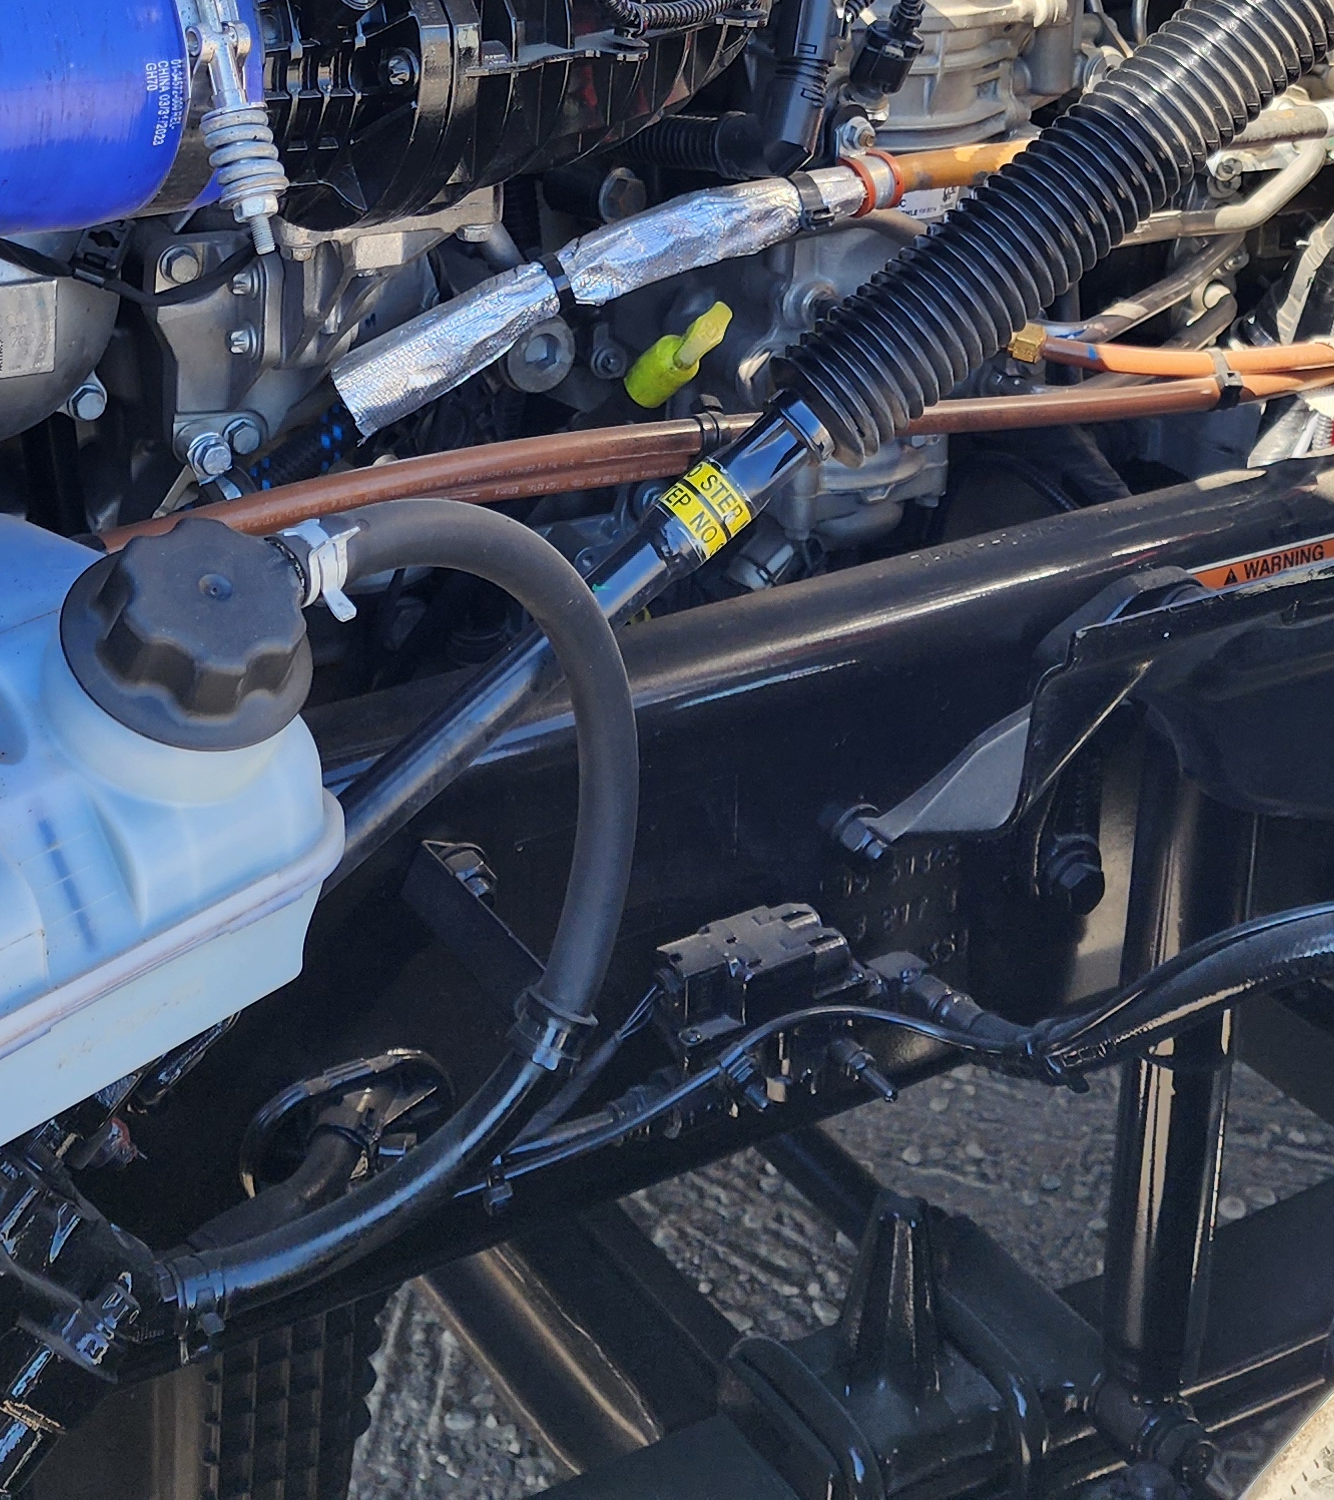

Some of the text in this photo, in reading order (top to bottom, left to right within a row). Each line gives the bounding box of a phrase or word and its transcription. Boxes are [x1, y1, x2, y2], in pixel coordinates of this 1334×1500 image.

[145, 62, 158, 91] GH70
[157, 60, 170, 93] CHINA
[665, 485, 718, 544] EP NO
[1243, 544, 1325, 579] WARNING
